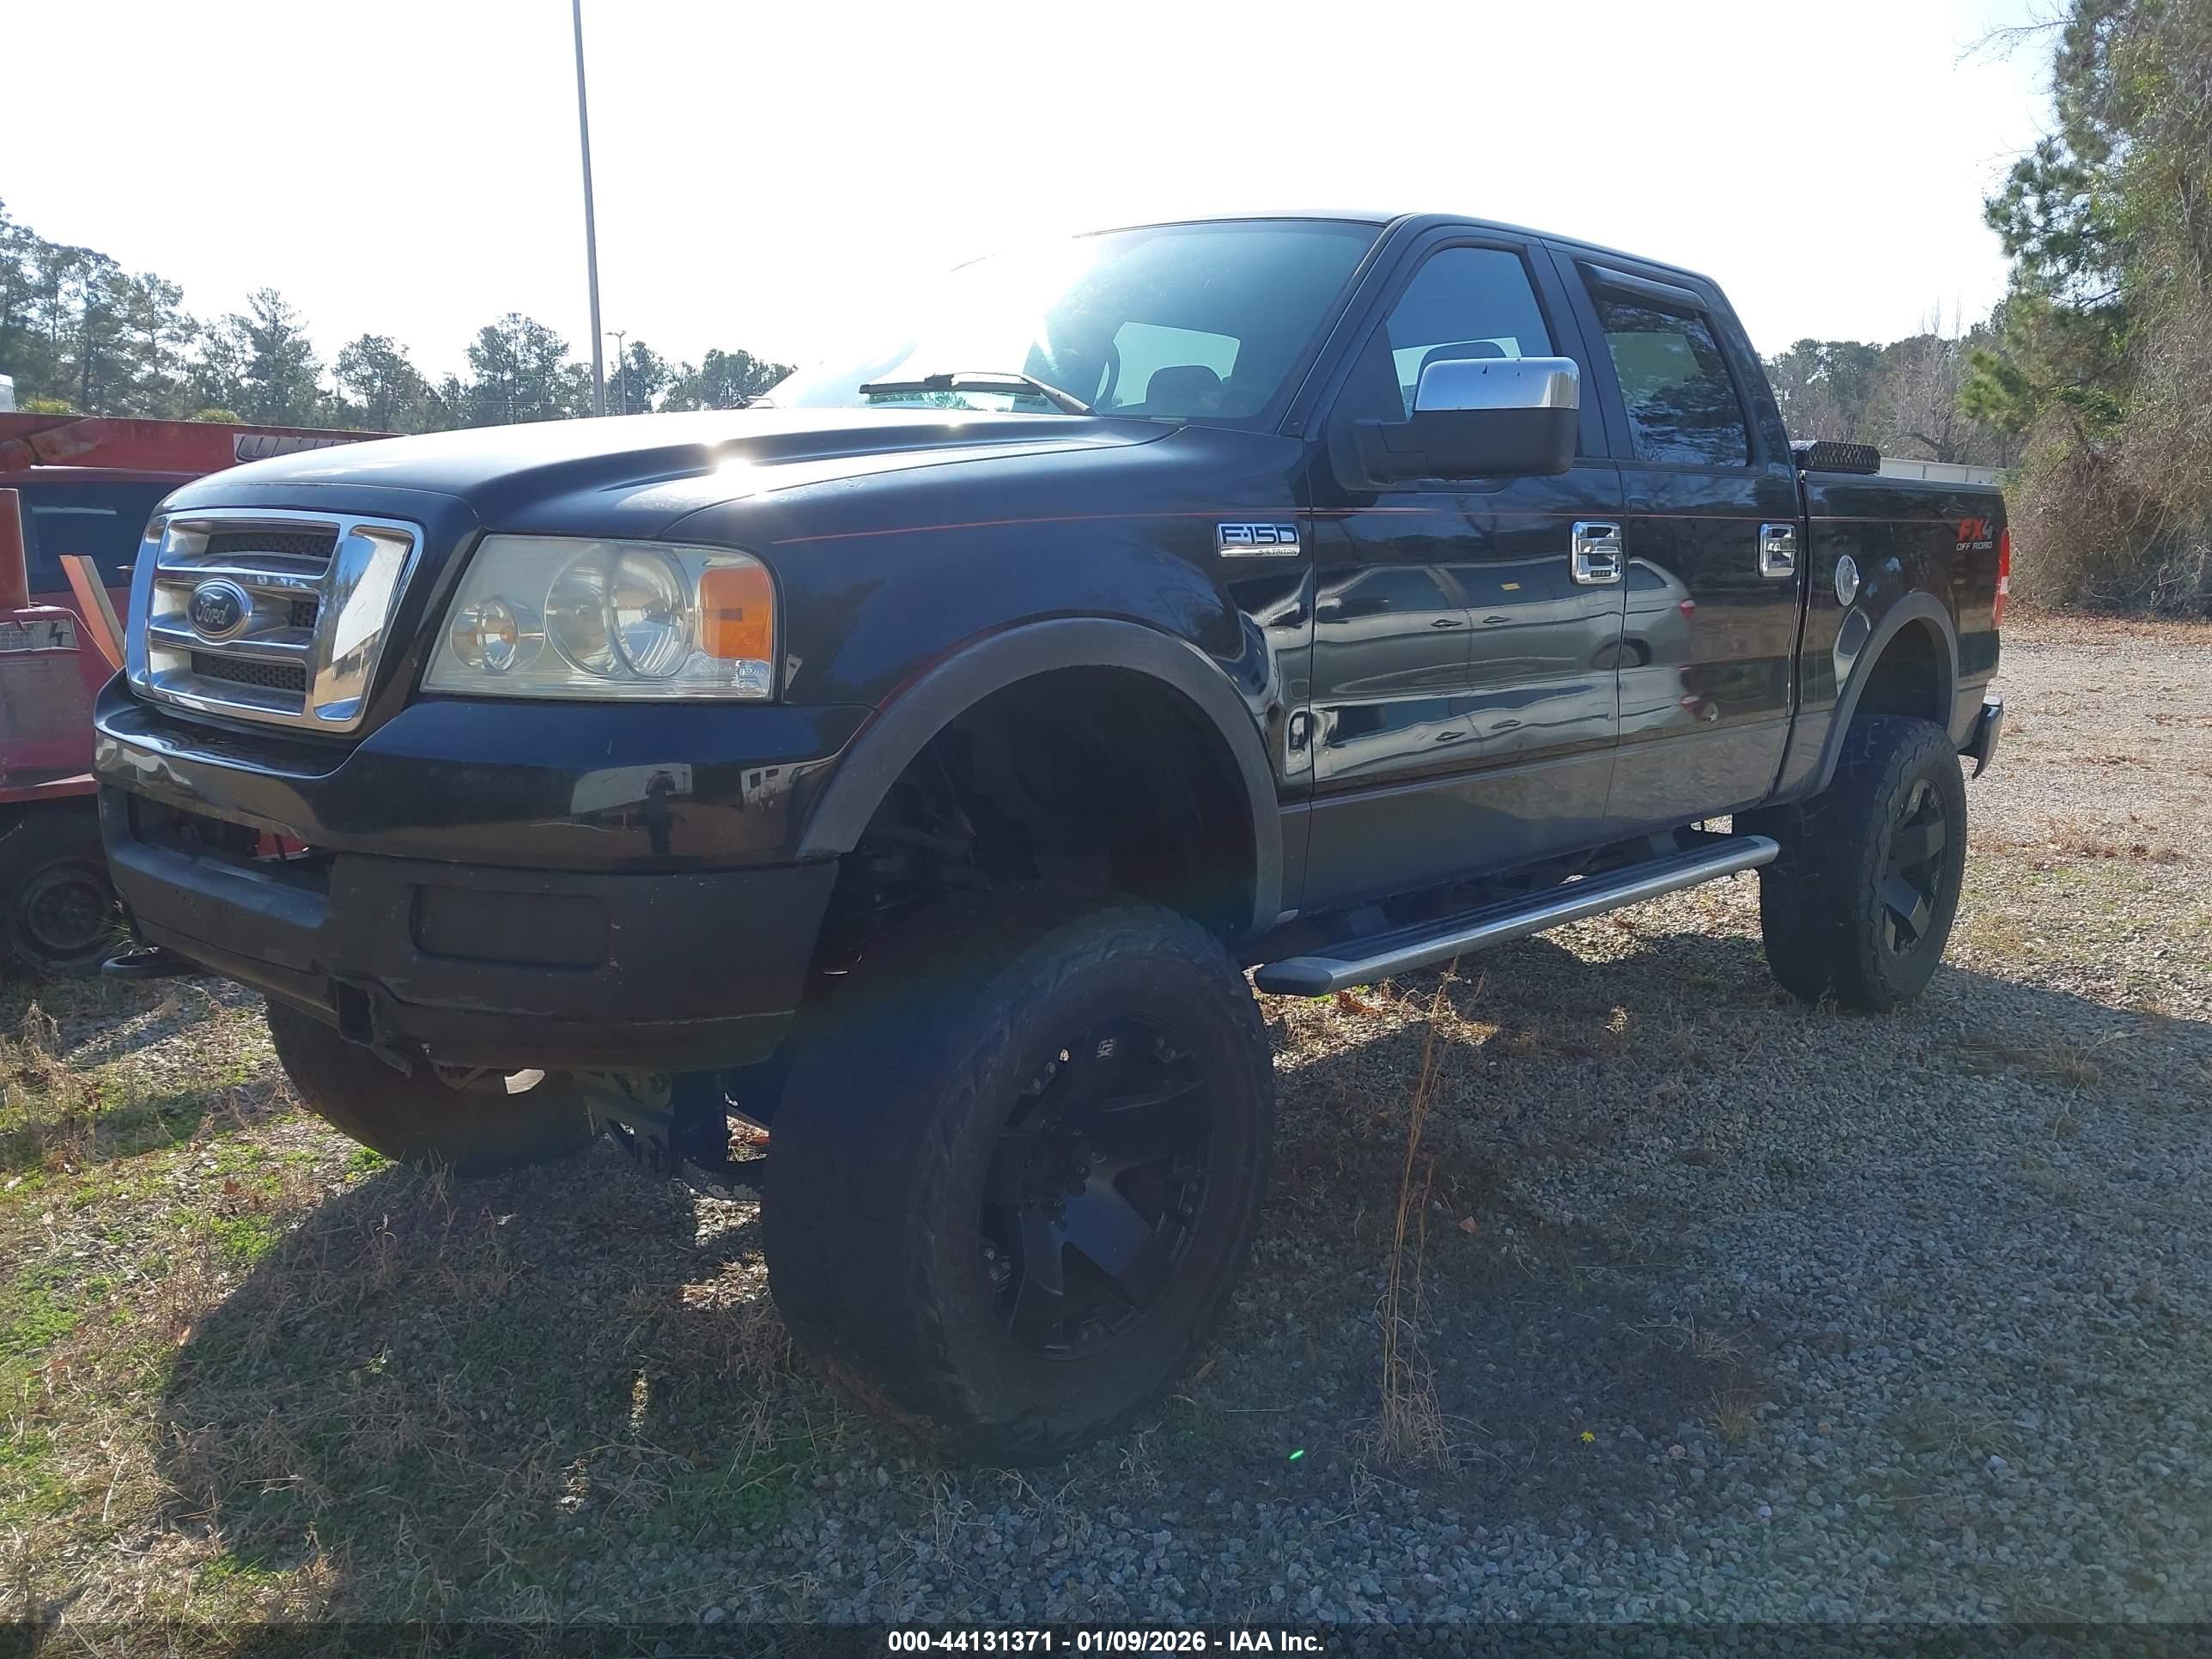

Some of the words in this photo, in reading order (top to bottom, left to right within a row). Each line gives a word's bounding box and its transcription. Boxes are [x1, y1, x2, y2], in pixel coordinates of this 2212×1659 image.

[1959, 519, 1993, 542] FX4
[1956, 542, 1972, 551] OFF
[1972, 541, 1993, 550] ROAD
[196, 592, 231, 625] Ford
